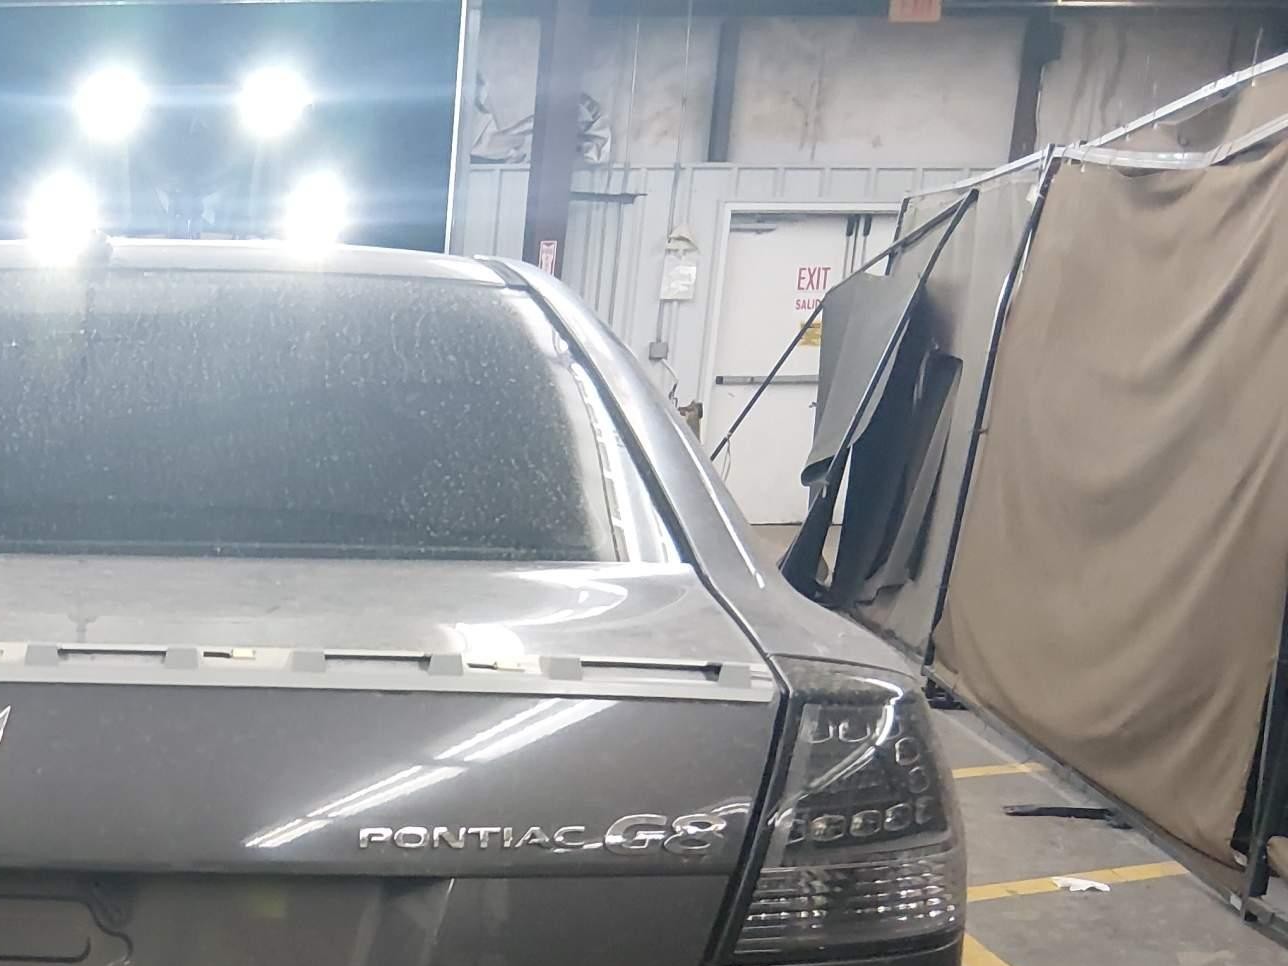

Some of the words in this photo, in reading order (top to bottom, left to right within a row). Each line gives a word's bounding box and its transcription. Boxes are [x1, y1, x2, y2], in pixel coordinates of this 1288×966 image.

[797, 266, 831, 290] EXIT
[795, 299, 822, 310] SALID
[358, 825, 600, 853] PONTIAC
[604, 813, 727, 855] G8
